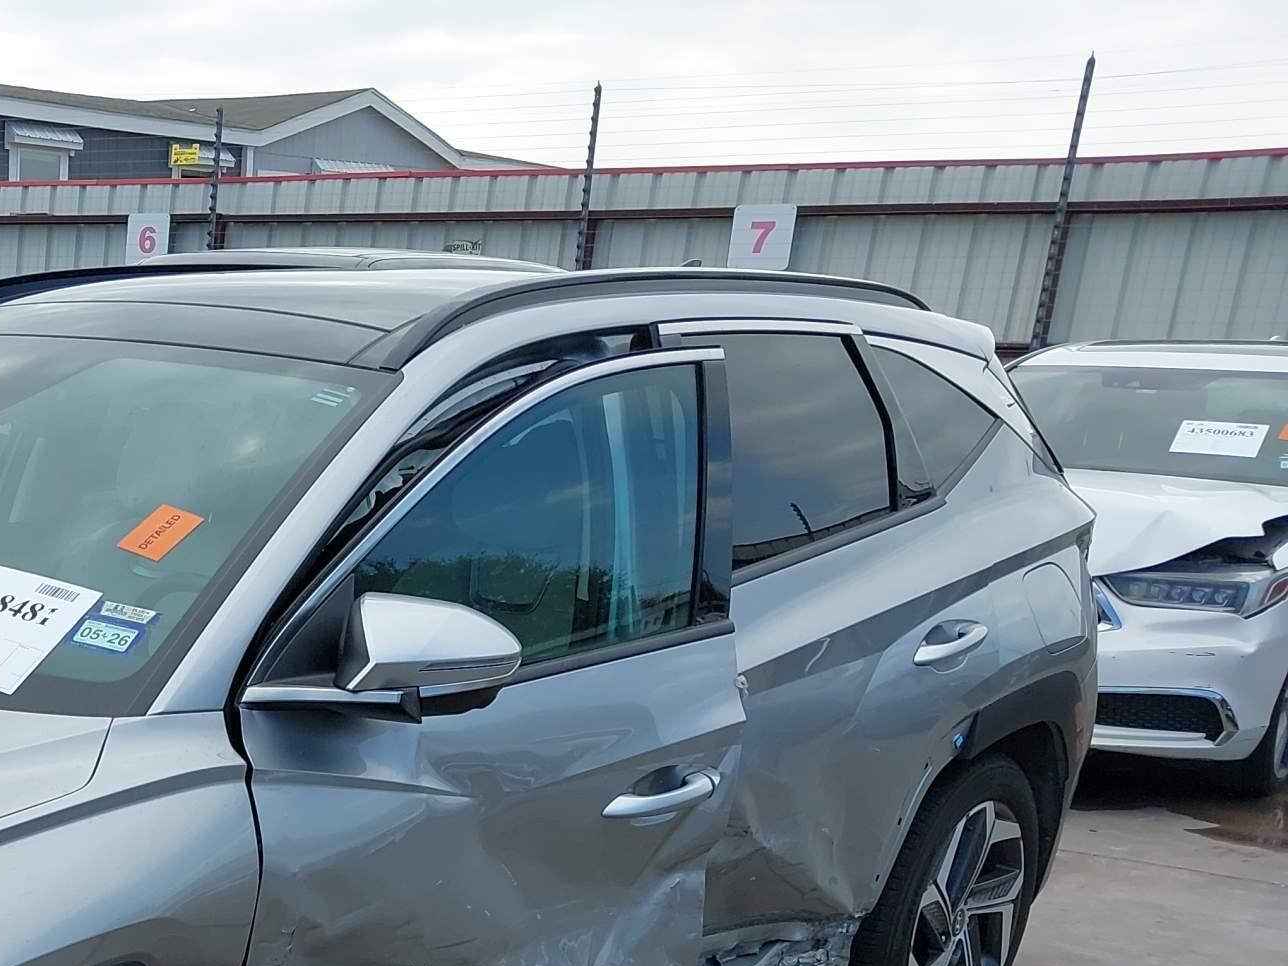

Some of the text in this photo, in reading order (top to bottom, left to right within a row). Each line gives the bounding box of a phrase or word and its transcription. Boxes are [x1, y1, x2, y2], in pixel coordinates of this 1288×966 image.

[139, 226, 157, 253] 6
[750, 221, 776, 254] 7
[138, 514, 181, 550] DETAILED
[79, 626, 131, 647] 05 26
